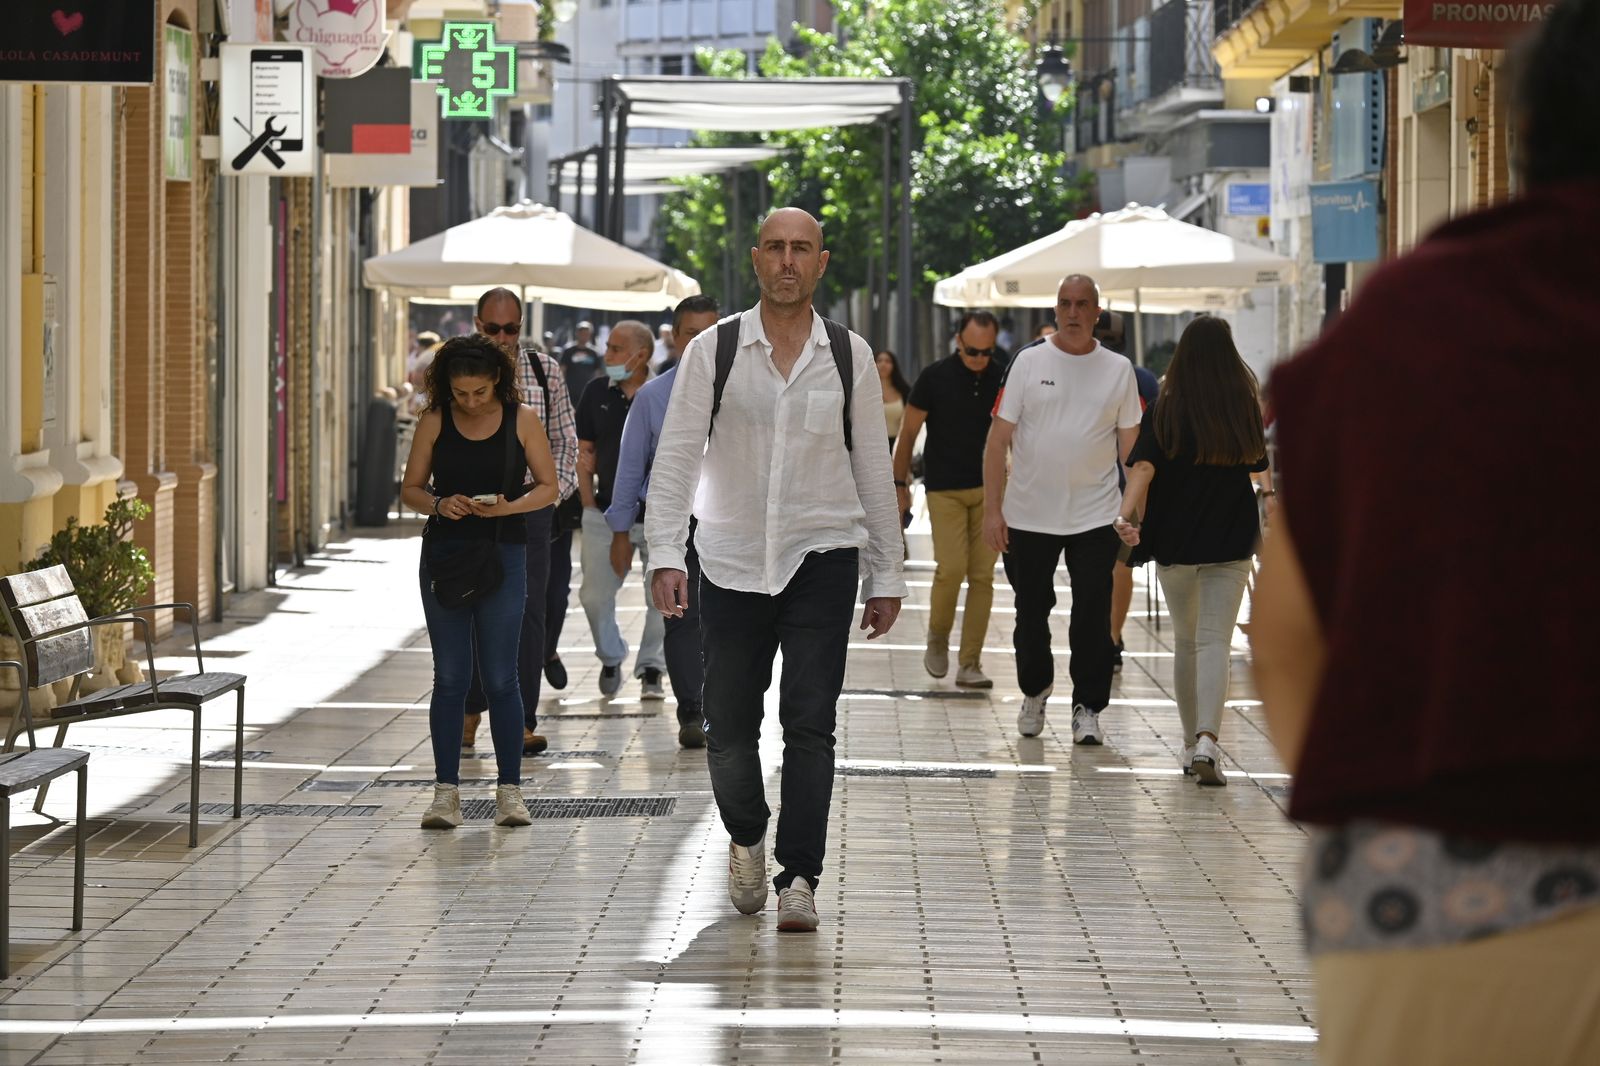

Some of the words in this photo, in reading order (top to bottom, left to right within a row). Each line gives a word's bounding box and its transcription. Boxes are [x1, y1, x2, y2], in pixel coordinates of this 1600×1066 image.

[296, 27, 377, 46] Chiguagua
[0, 50, 36, 61] LOLA
[43, 50, 141, 62] CASADEMUNT
[322, 67, 352, 76] outlet
[1312, 194, 1353, 206] Sanitas
